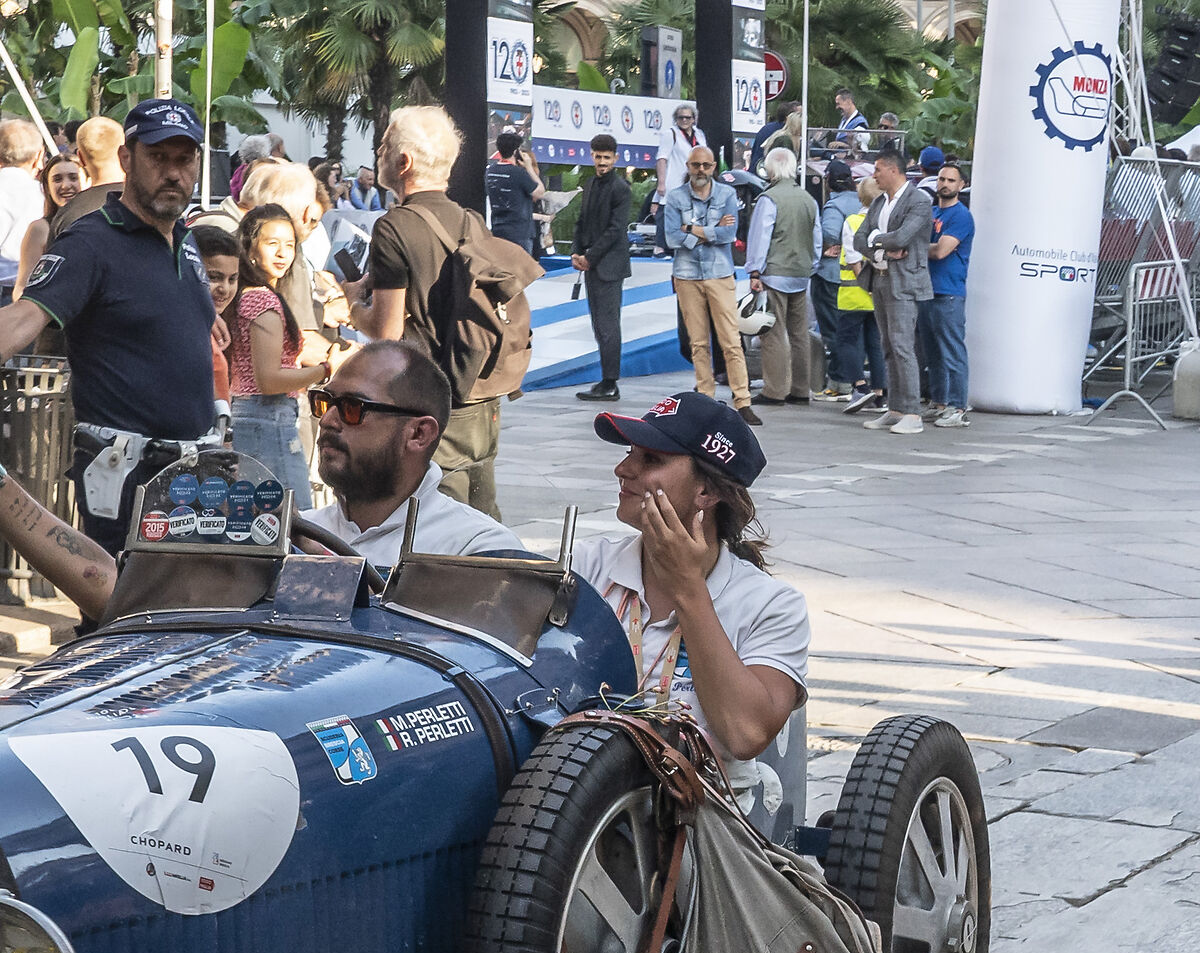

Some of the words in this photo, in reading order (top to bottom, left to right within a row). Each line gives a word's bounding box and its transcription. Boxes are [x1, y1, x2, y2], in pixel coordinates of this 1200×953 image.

[1011, 244, 1068, 261] Automobile
[1019, 262, 1096, 283] SPORT
[701, 434, 737, 464] 1927
[714, 431, 734, 448] Since
[145, 522, 165, 532] 2015
[398, 731, 418, 748] R.
[417, 716, 475, 744] PERLETTI
[110, 736, 216, 804] 19
[130, 835, 192, 856] CHOPARD
